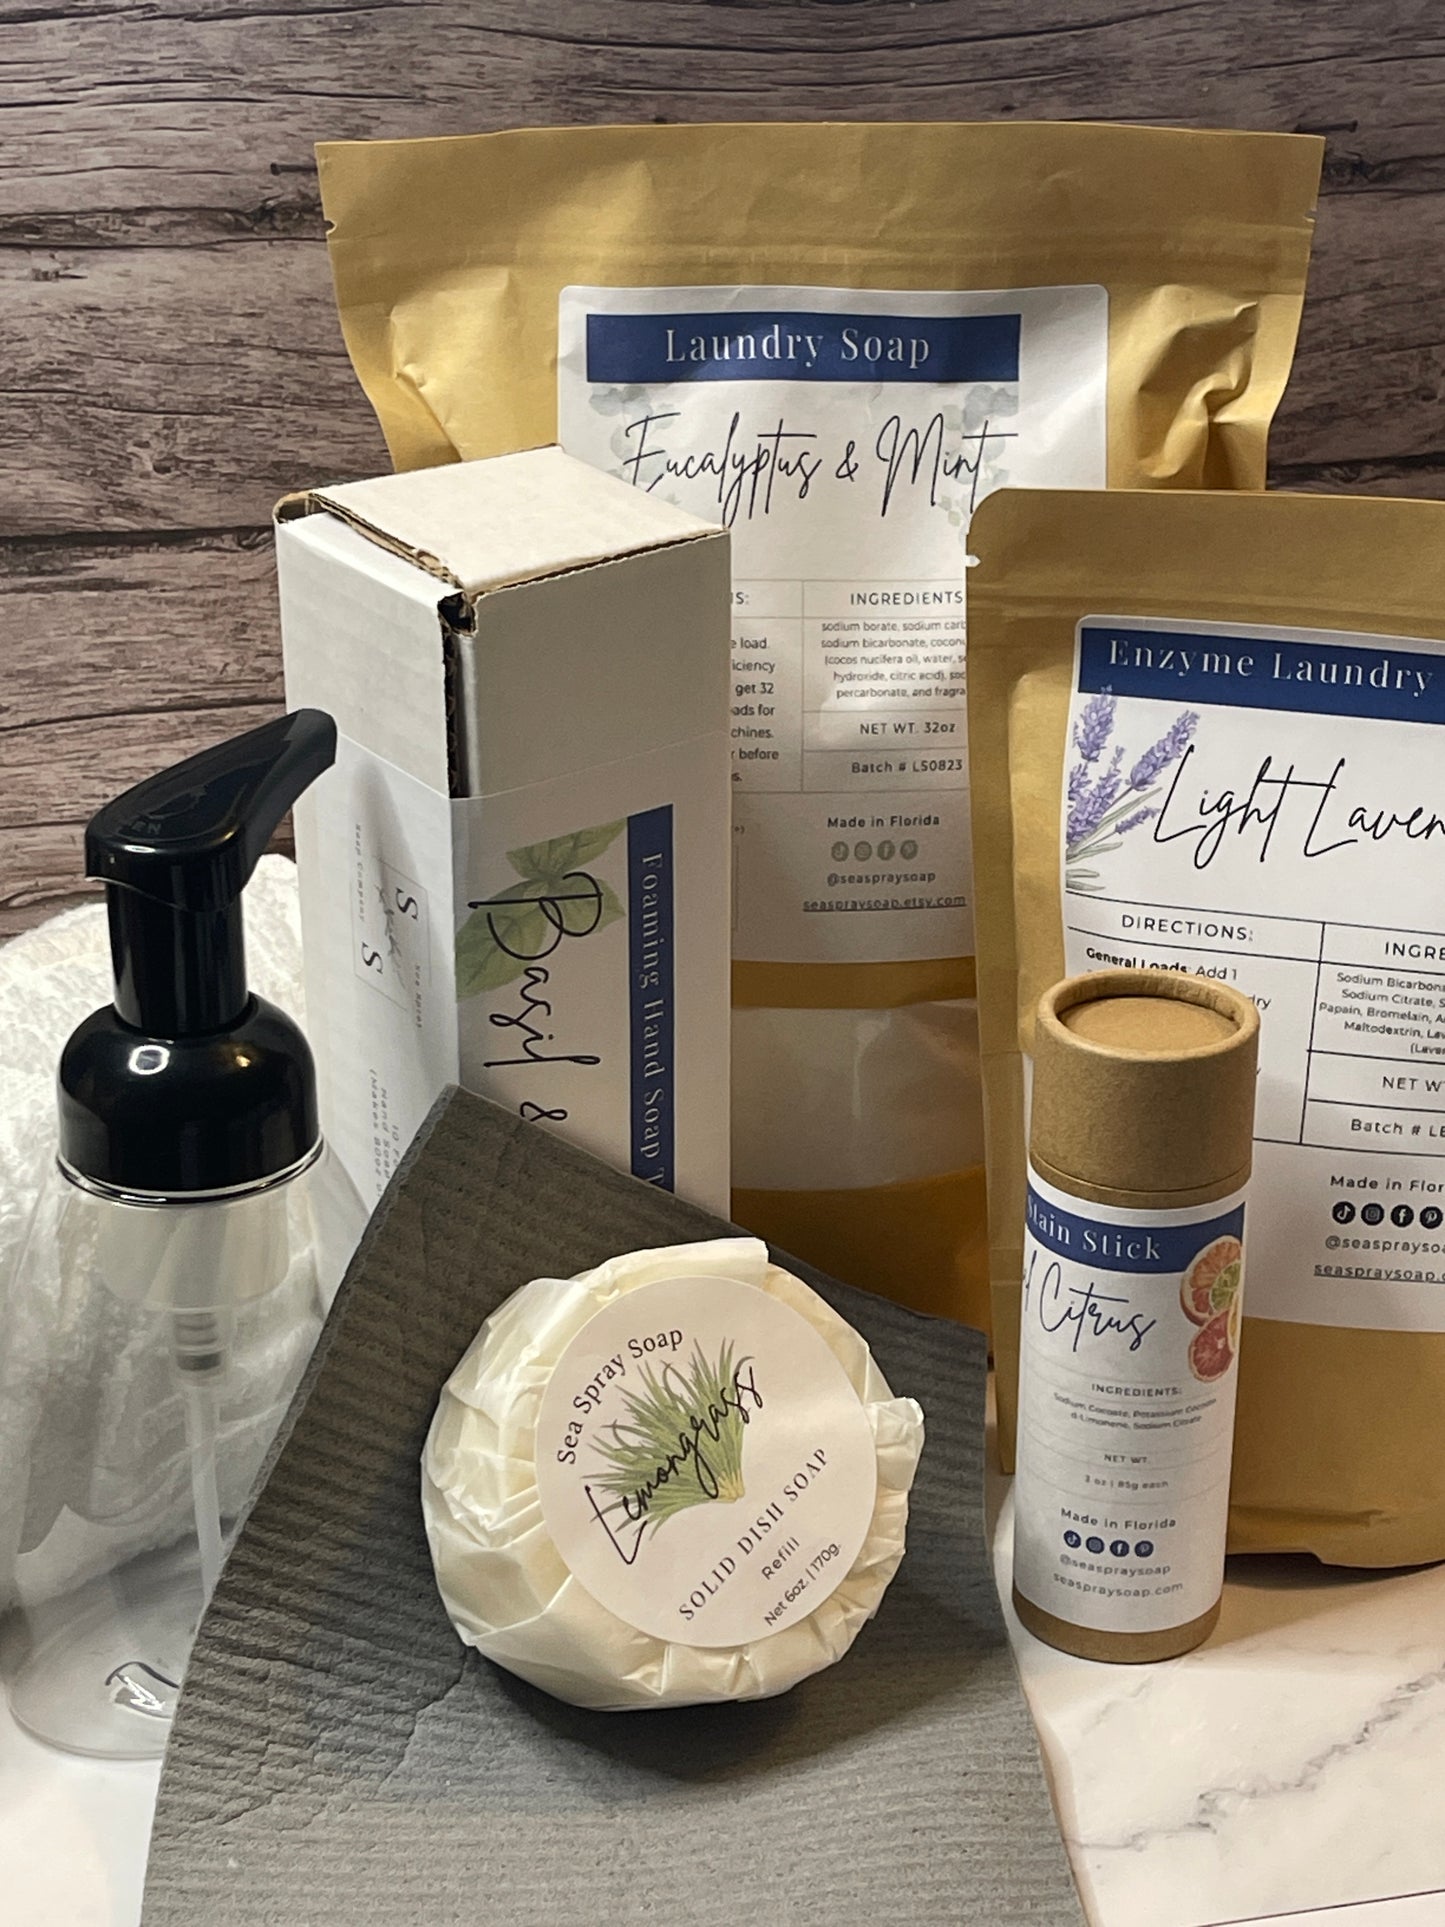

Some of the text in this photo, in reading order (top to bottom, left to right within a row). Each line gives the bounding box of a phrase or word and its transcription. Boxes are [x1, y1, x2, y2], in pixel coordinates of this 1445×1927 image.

[665, 323, 931, 368] Laundry Soap
[623, 411, 1019, 527] Eucalyptus & Mint
[850, 591, 963, 605] INGREDIENTS
[822, 621, 860, 632] sodium
[863, 621, 900, 632] borate,
[903, 621, 941, 632] sodium
[821, 637, 859, 648] sodium
[862, 637, 928, 649] bicarbonate,
[861, 654, 903, 665] nucifera
[906, 654, 920, 666] oil,
[923, 654, 955, 665] water,
[1108, 638, 1434, 697] Enzyme Laundry
[833, 670, 888, 683] hydroxide,
[890, 670, 915, 681] citric
[735, 682, 774, 697] get 32
[836, 687, 910, 699] percarbonate,
[912, 687, 932, 697] and
[758, 704, 775, 716] for
[860, 723, 887, 735] NET
[924, 722, 956, 734] 32oz
[739, 749, 779, 761] before
[851, 759, 963, 774] Batch # LS0823
[1154, 744, 1337, 869] Light
[827, 814, 940, 829] Made in Florida
[827, 871, 936, 888] @seaspraysoap
[395, 887, 418, 920] S
[803, 894, 967, 912] seaspraysoap.etsy.com
[640, 852, 664, 989] Foaming
[1121, 914, 1254, 942] DIRECTIONS:
[361, 942, 383, 974] S
[1385, 942, 1445, 961] INGRE
[467, 872, 604, 1069] Basil
[1086, 947, 1137, 969] General
[1196, 965, 1227, 980] Add
[1231, 968, 1238, 981] 1
[1337, 972, 1383, 986] Sodium
[1342, 989, 1388, 1002] Sodium
[1392, 994, 1435, 1008] Citrate,
[1319, 1002, 1363, 1016] Papain,
[1367, 1007, 1432, 1024] Bromelain,
[1344, 1021, 1424, 1038] Maltodextrin,
[642, 999, 665, 1080] Hand
[1382, 1075, 1419, 1091] NET
[640, 1090, 665, 1160] Soap
[1351, 1119, 1403, 1135] Batch
[1411, 1124, 1421, 1136] #
[1330, 1175, 1445, 1193] Made in Flor
[1028, 1194, 1161, 1260] Stain Stick
[1040, 1262, 1157, 1352] Citrus
[556, 1328, 684, 1466] Sea Spray Soap
[1091, 1383, 1182, 1397] INGREDIENTS:
[584, 1365, 764, 1564] Lemongrass
[1104, 1454, 1126, 1463] NET
[1094, 1478, 1106, 1486] oz
[1142, 1480, 1169, 1489] each
[1061, 1507, 1176, 1530] Made in Florida
[678, 1448, 829, 1621] SOLID DISH SOAP
[760, 1536, 801, 1581] Refill
[1059, 1554, 1171, 1577] @seaspraysoap
[1053, 1572, 1184, 1597] seaspraysoap.com
[764, 1600, 788, 1626] Net
